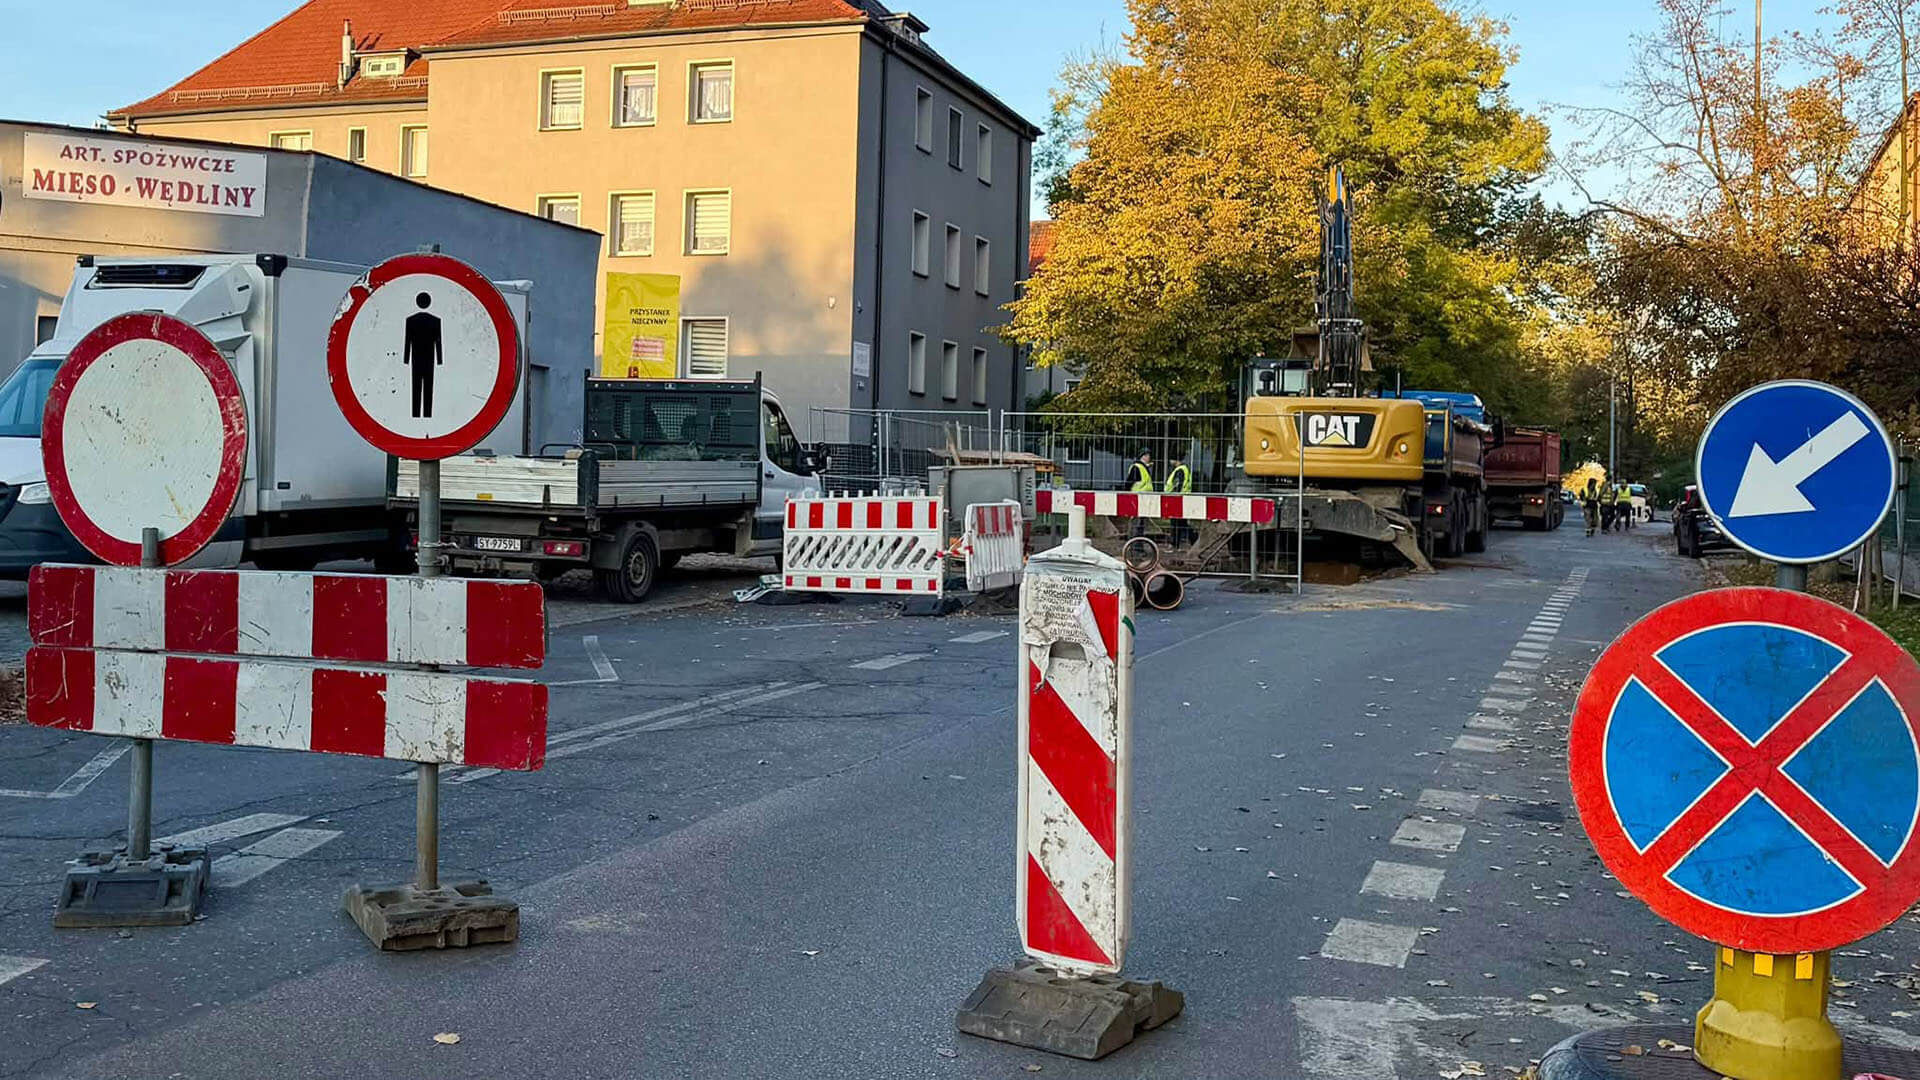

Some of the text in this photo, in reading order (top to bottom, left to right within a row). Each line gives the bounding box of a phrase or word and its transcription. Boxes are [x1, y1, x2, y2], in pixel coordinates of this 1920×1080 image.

[60, 144, 236, 173] ART. SPOŻYWCZE
[32, 168, 116, 200] MIĘSO
[135, 176, 257, 208] WĘDLINY
[630, 308, 670, 316] PRZYSTANEK
[632, 317, 668, 325] NIECZYNNY
[1308, 414, 1360, 446] CAT
